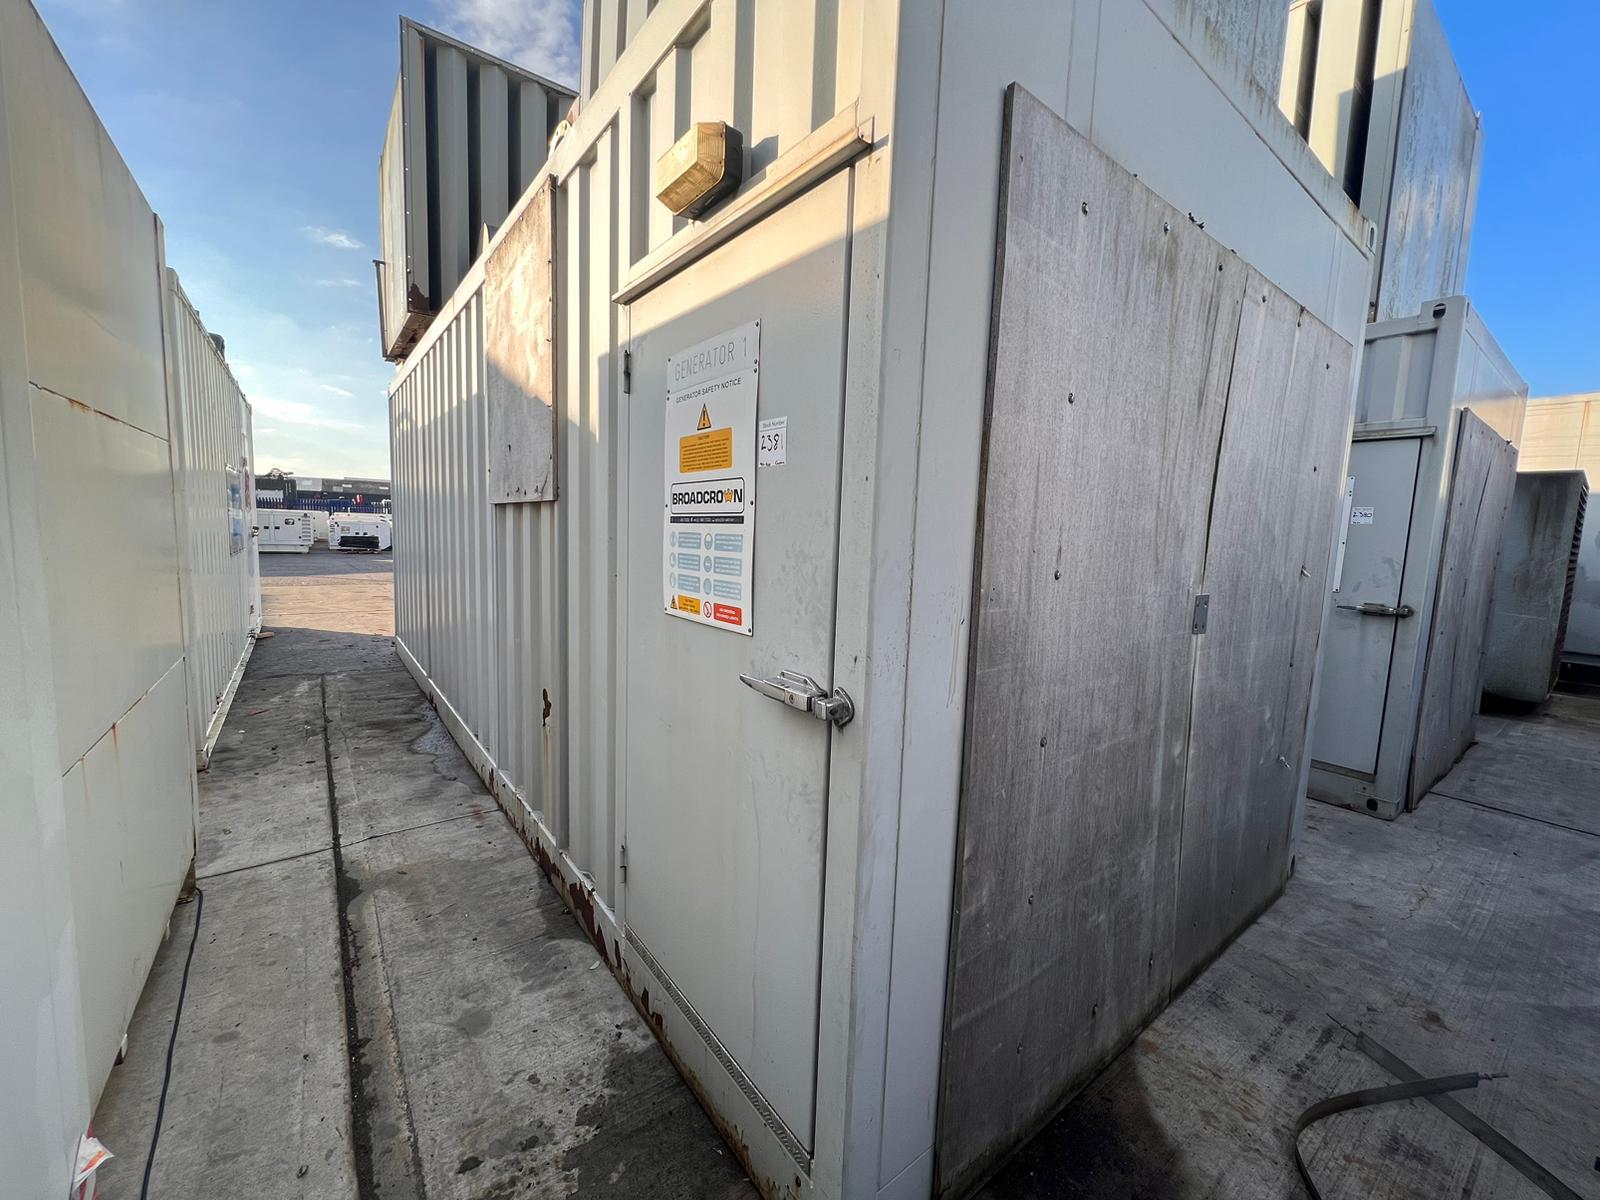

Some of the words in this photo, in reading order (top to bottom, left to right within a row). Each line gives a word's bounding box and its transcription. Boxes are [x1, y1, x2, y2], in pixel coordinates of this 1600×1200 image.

[674, 341, 735, 382] GENERATOR
[742, 336, 748, 358] 1
[676, 390, 702, 404] GENERATOR
[702, 383, 720, 395] SAFETY
[721, 377, 742, 391] NOTICE
